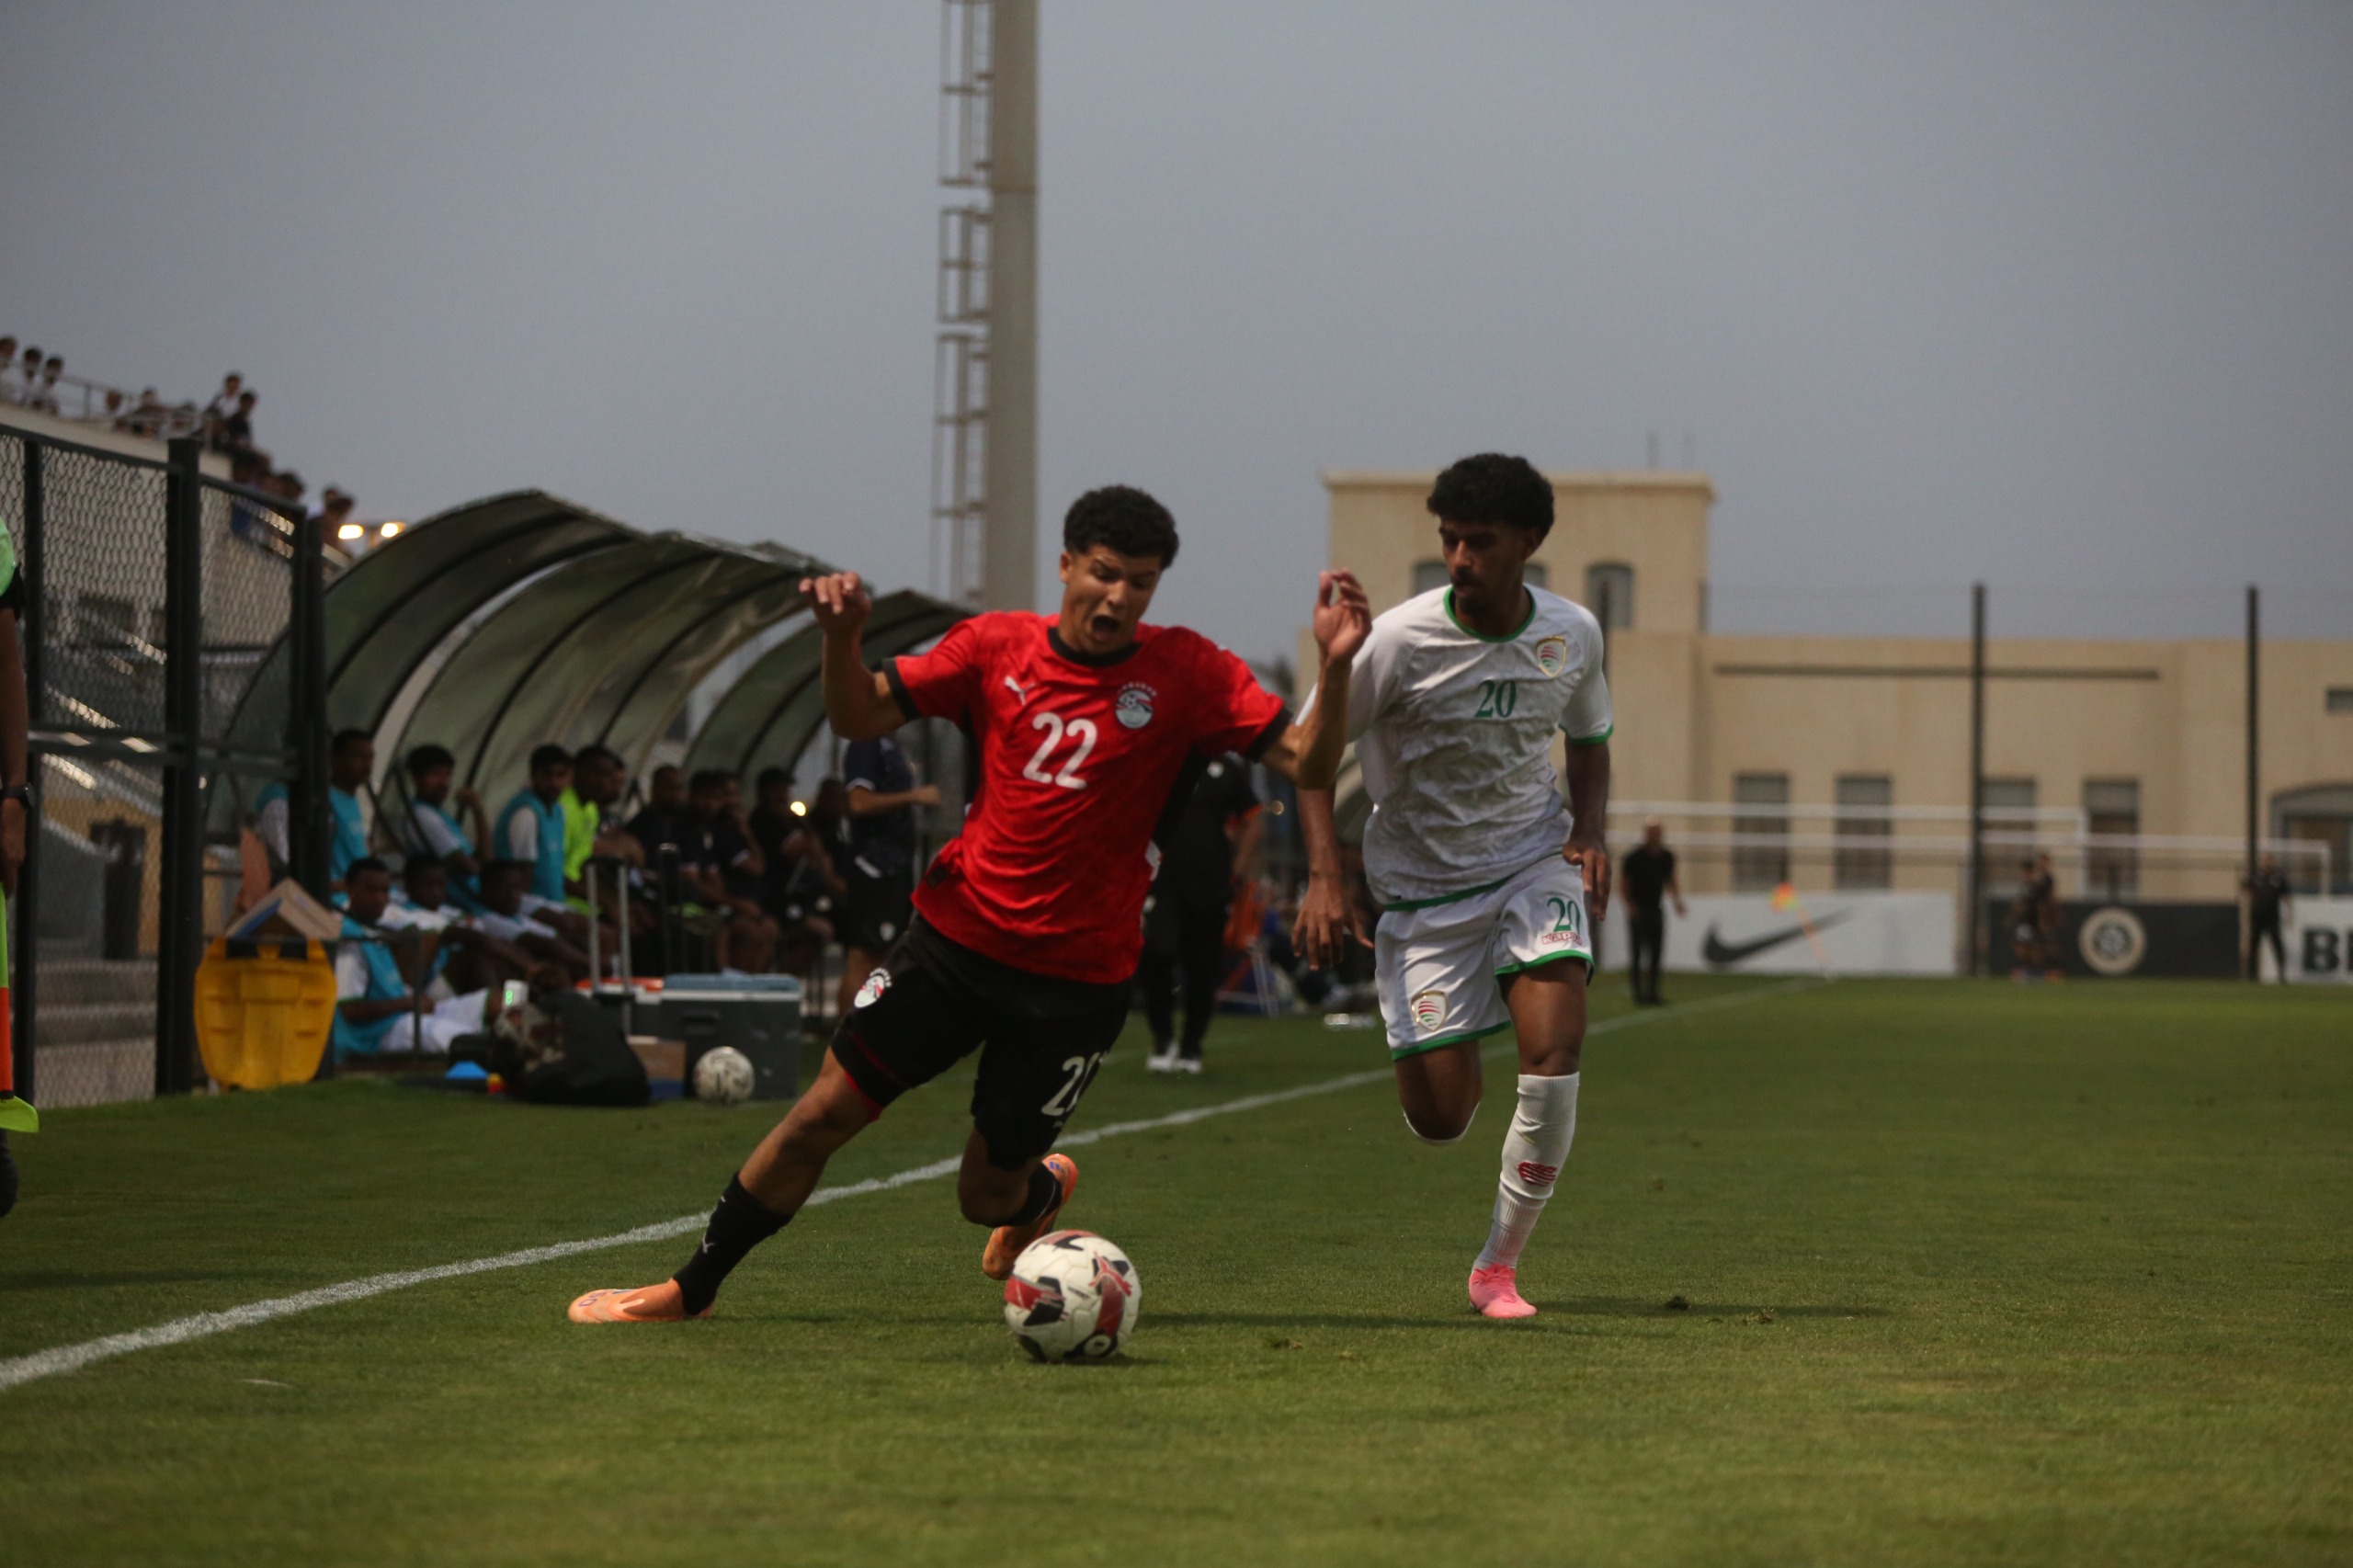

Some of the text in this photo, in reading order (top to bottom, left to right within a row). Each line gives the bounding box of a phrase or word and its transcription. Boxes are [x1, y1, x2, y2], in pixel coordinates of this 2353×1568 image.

[1474, 679, 1517, 719] 20
[1022, 712, 1097, 790] 22
[1546, 897, 1580, 935] 20
[2303, 927, 2353, 972] B
